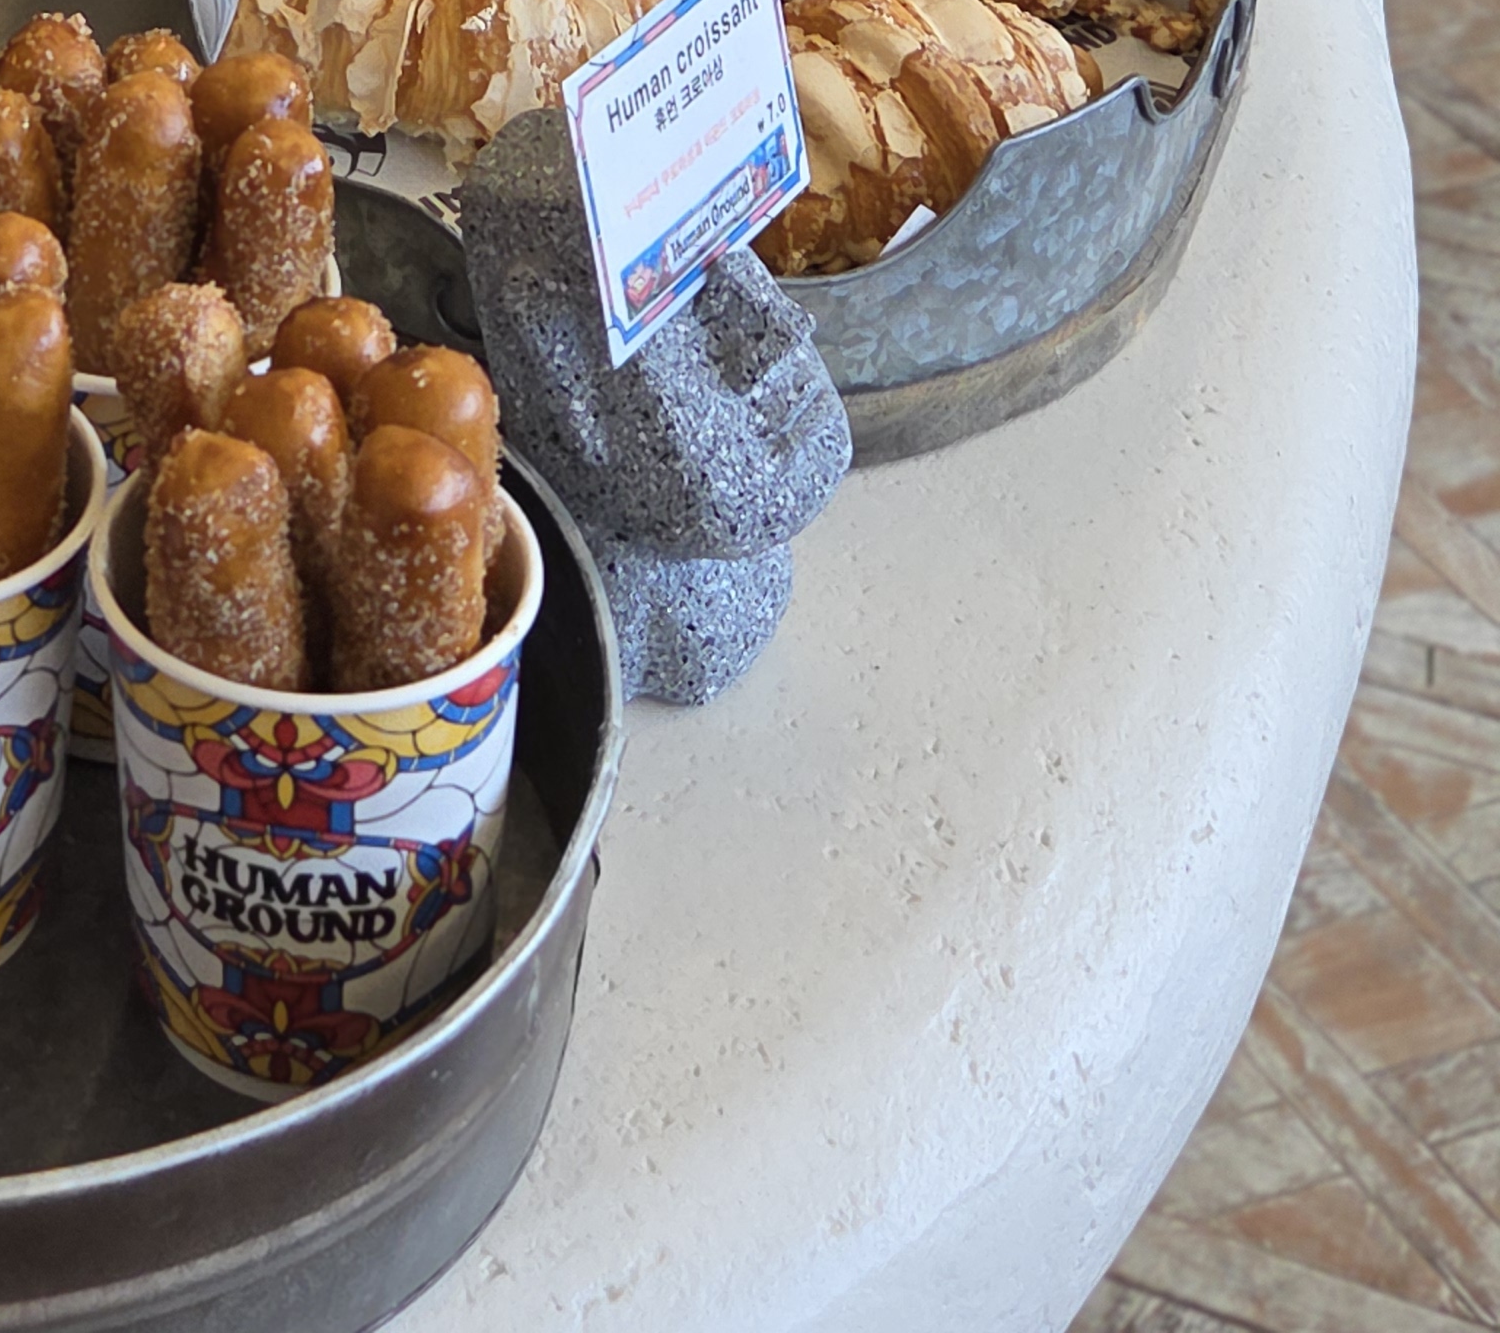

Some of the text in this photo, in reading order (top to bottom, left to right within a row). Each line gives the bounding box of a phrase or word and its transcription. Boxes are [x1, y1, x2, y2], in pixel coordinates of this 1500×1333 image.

[606, 60, 673, 134] Human
[653, 94, 680, 133] 휴먼
[184, 833, 398, 906] HUMAN
[181, 874, 397, 943] GROUND
